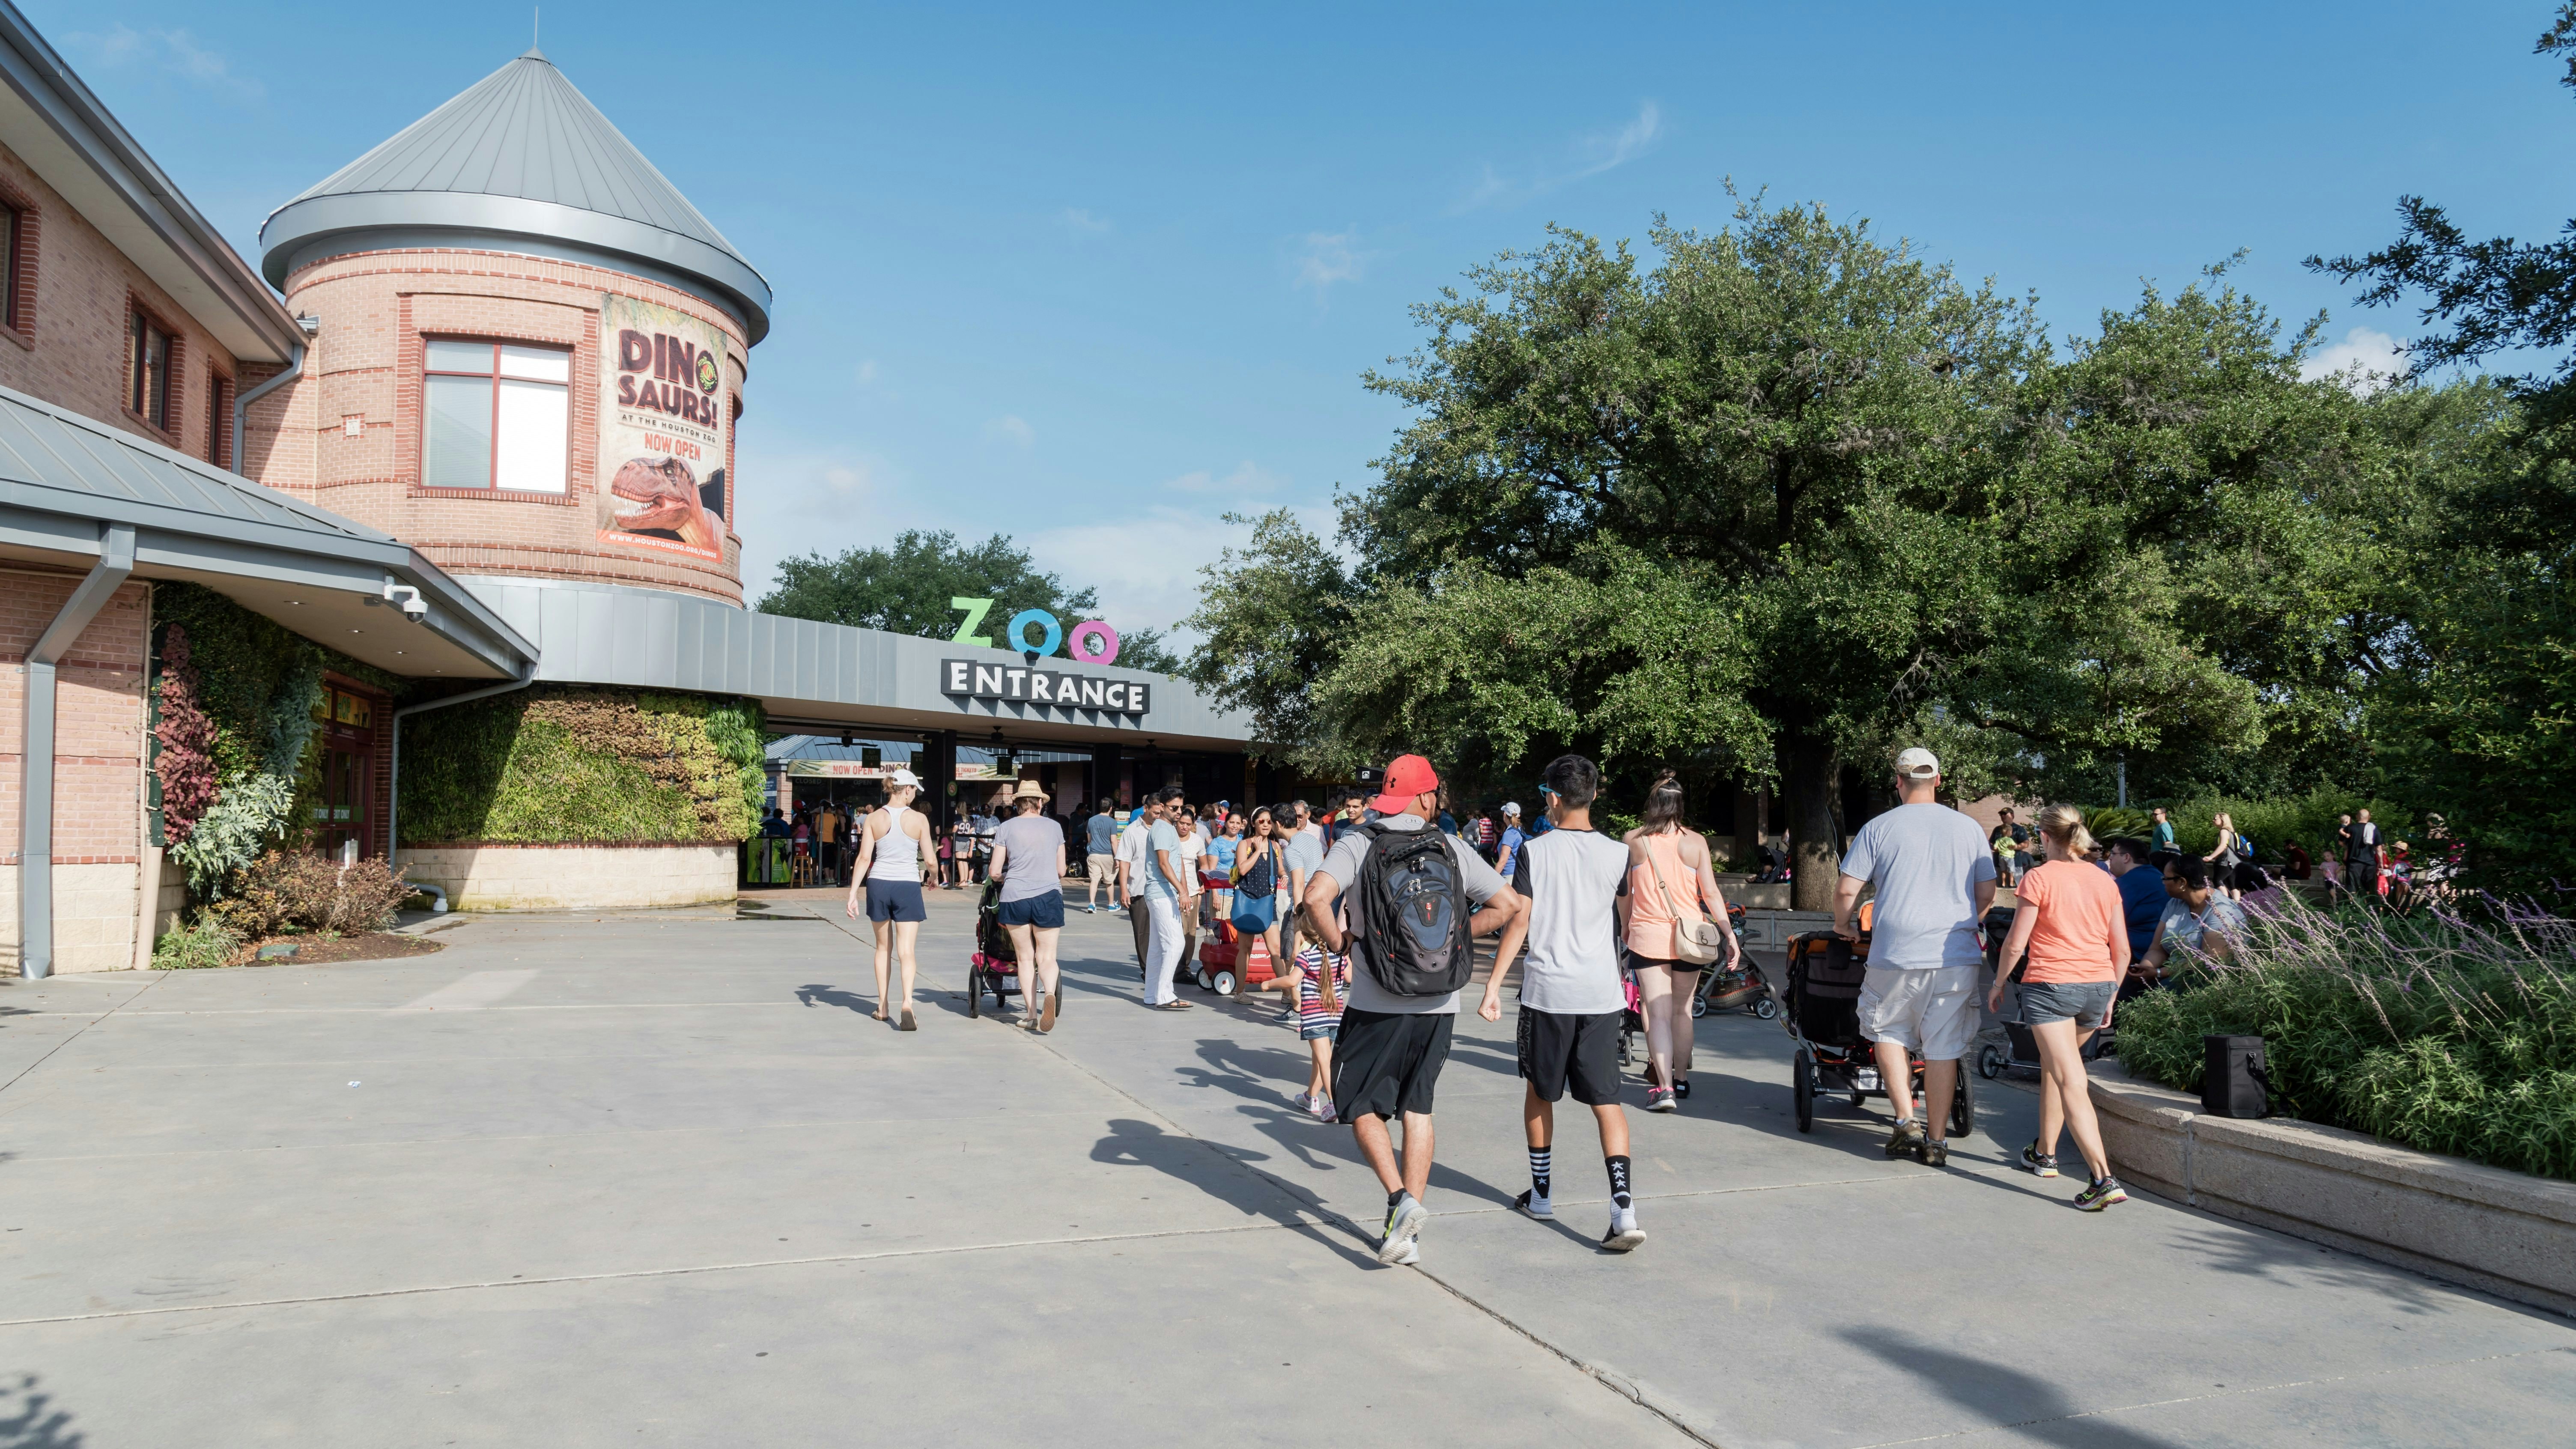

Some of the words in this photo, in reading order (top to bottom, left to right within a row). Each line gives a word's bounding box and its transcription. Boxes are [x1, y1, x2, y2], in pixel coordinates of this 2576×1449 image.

[619, 329, 719, 395] DINO
[618, 374, 718, 429] SAURS!
[639, 417, 656, 425] THE
[662, 422, 699, 436] HOUSTON
[704, 434, 716, 442] ZOO
[645, 432, 672, 453] NOW
[675, 439, 701, 461] OPEN
[609, 534, 717, 558] WWW.HOUSTONZOO.ORG/DINOS
[951, 596, 1119, 665] ZOO
[950, 662, 1143, 710] ENTRANCE
[833, 765, 850, 774] NOW
[853, 766, 873, 775] OPEN
[1246, 769, 1255, 781] 10
[957, 822, 970, 834] 99
